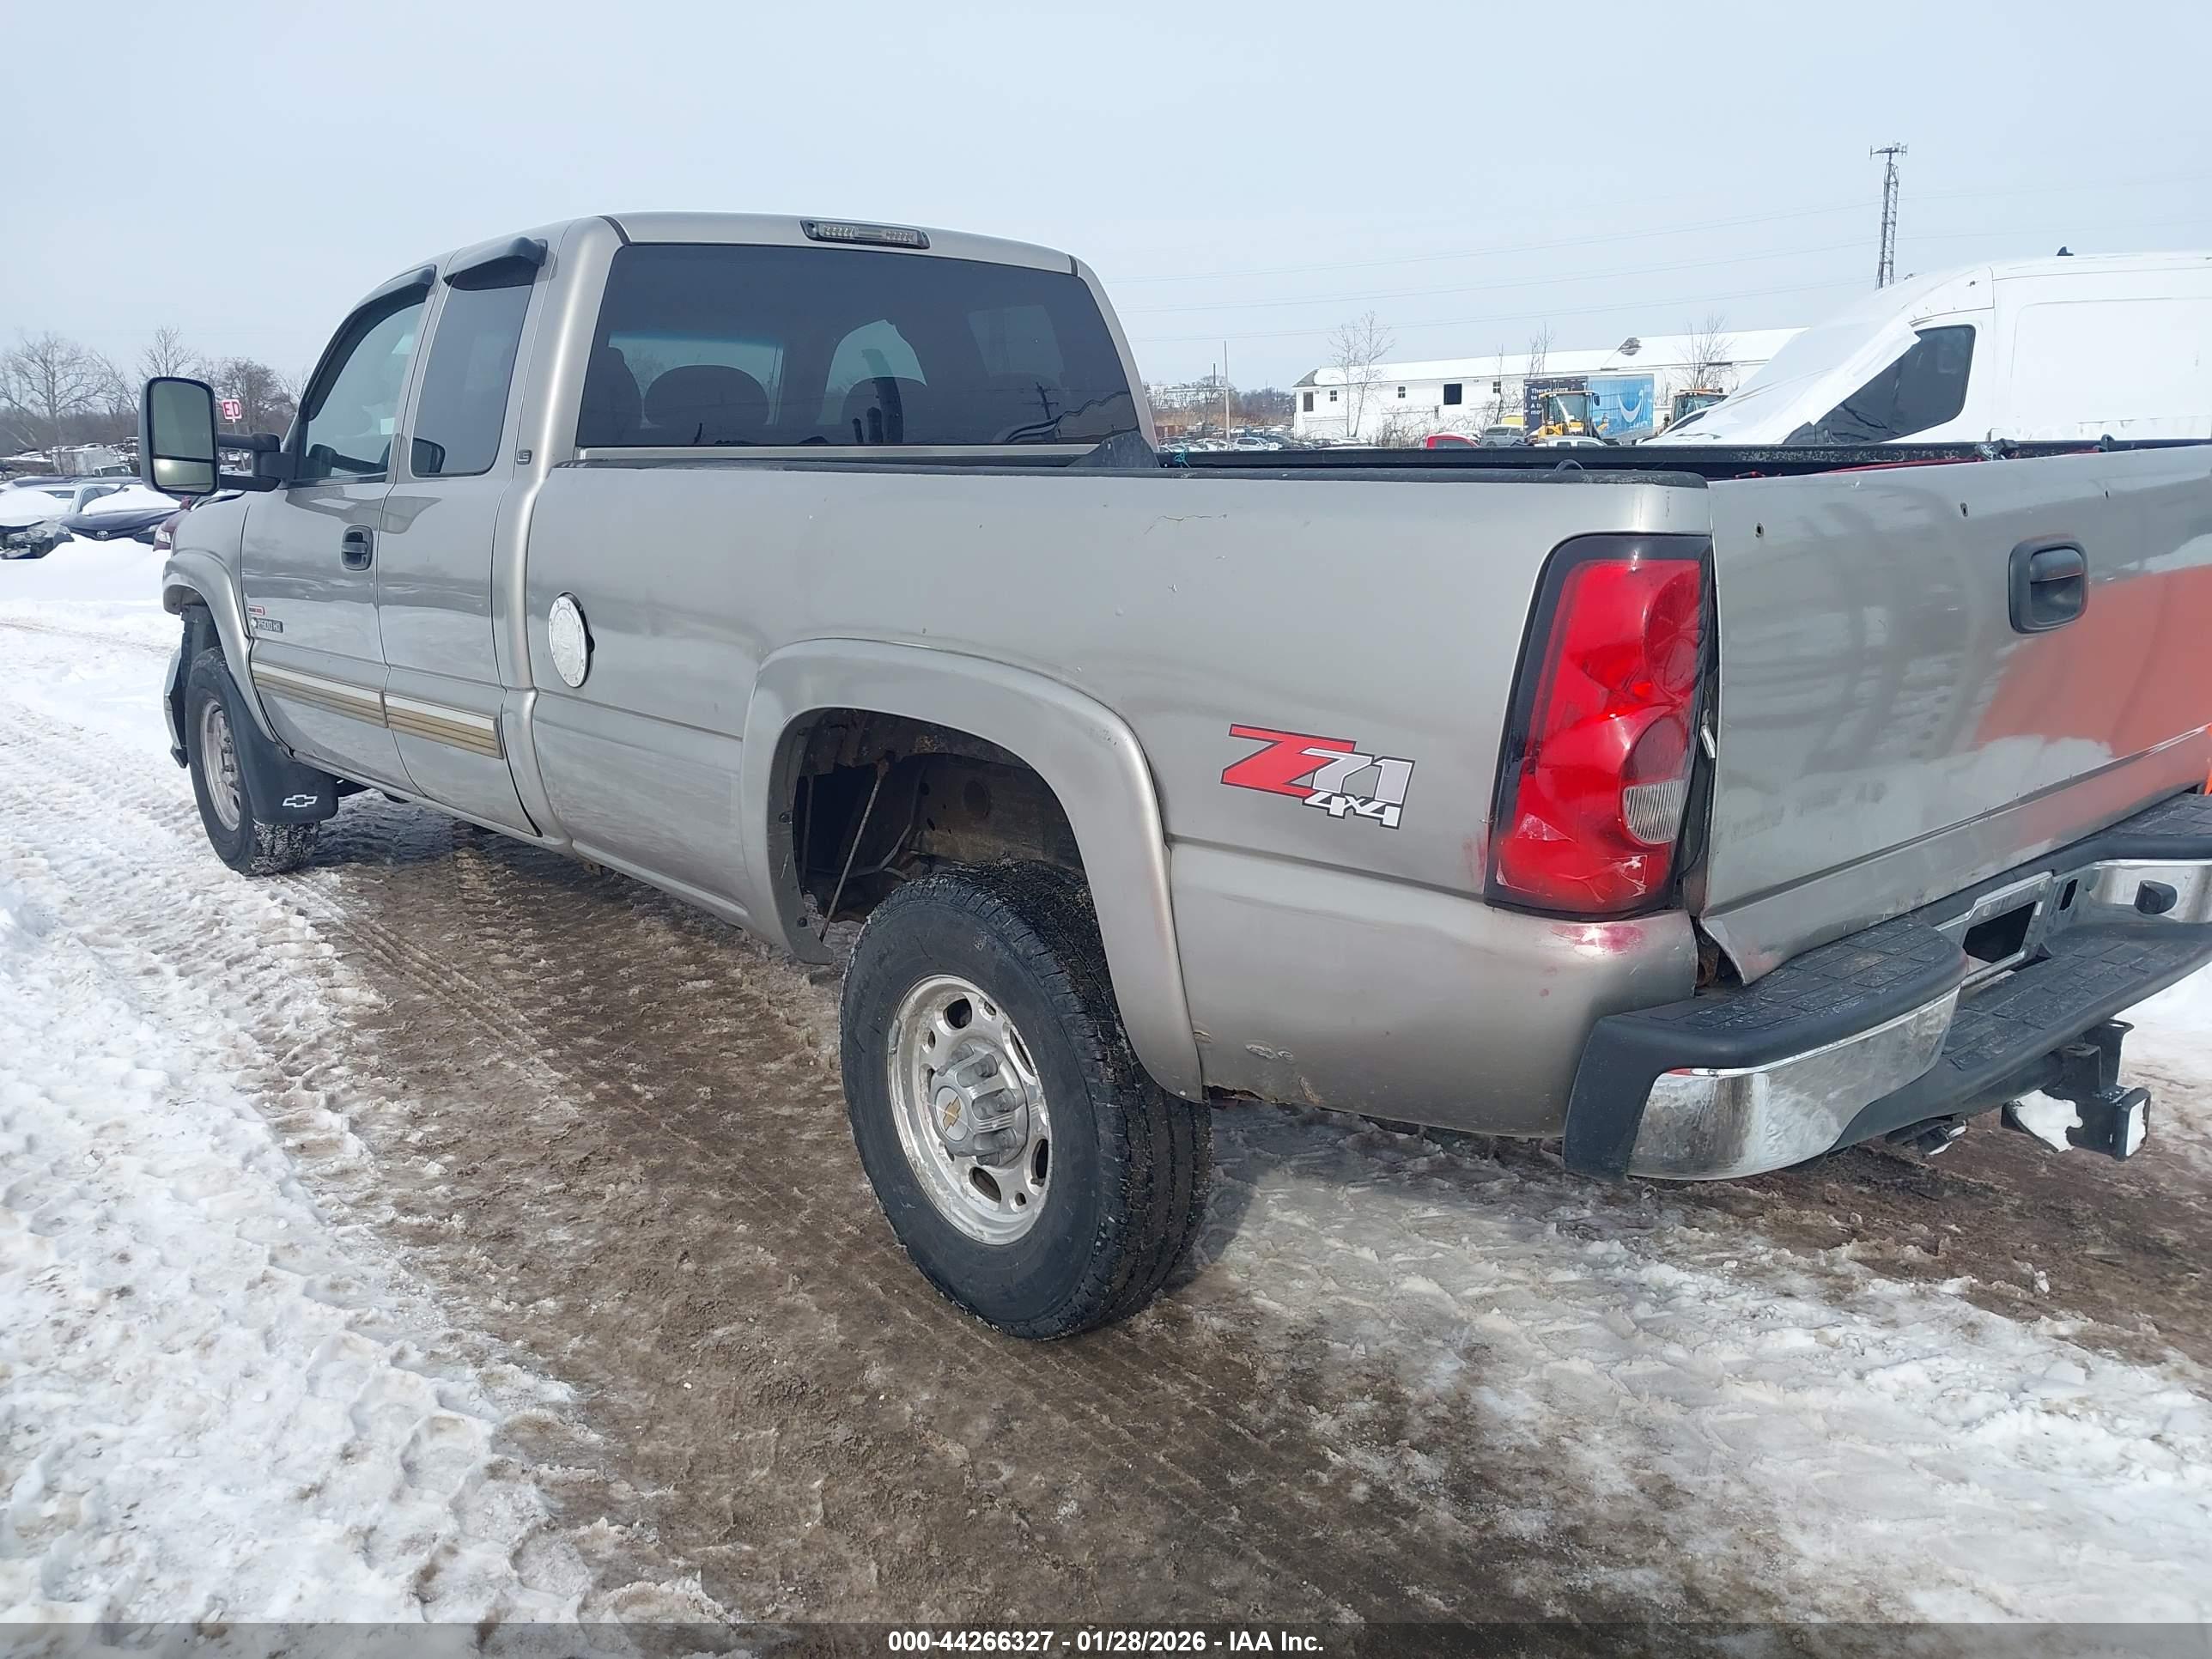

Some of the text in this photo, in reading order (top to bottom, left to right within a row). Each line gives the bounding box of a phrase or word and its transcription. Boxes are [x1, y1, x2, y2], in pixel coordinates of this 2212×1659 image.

[223, 402, 240, 416] ED
[258, 620, 273, 630] 2500
[1220, 723, 1415, 805] Z71
